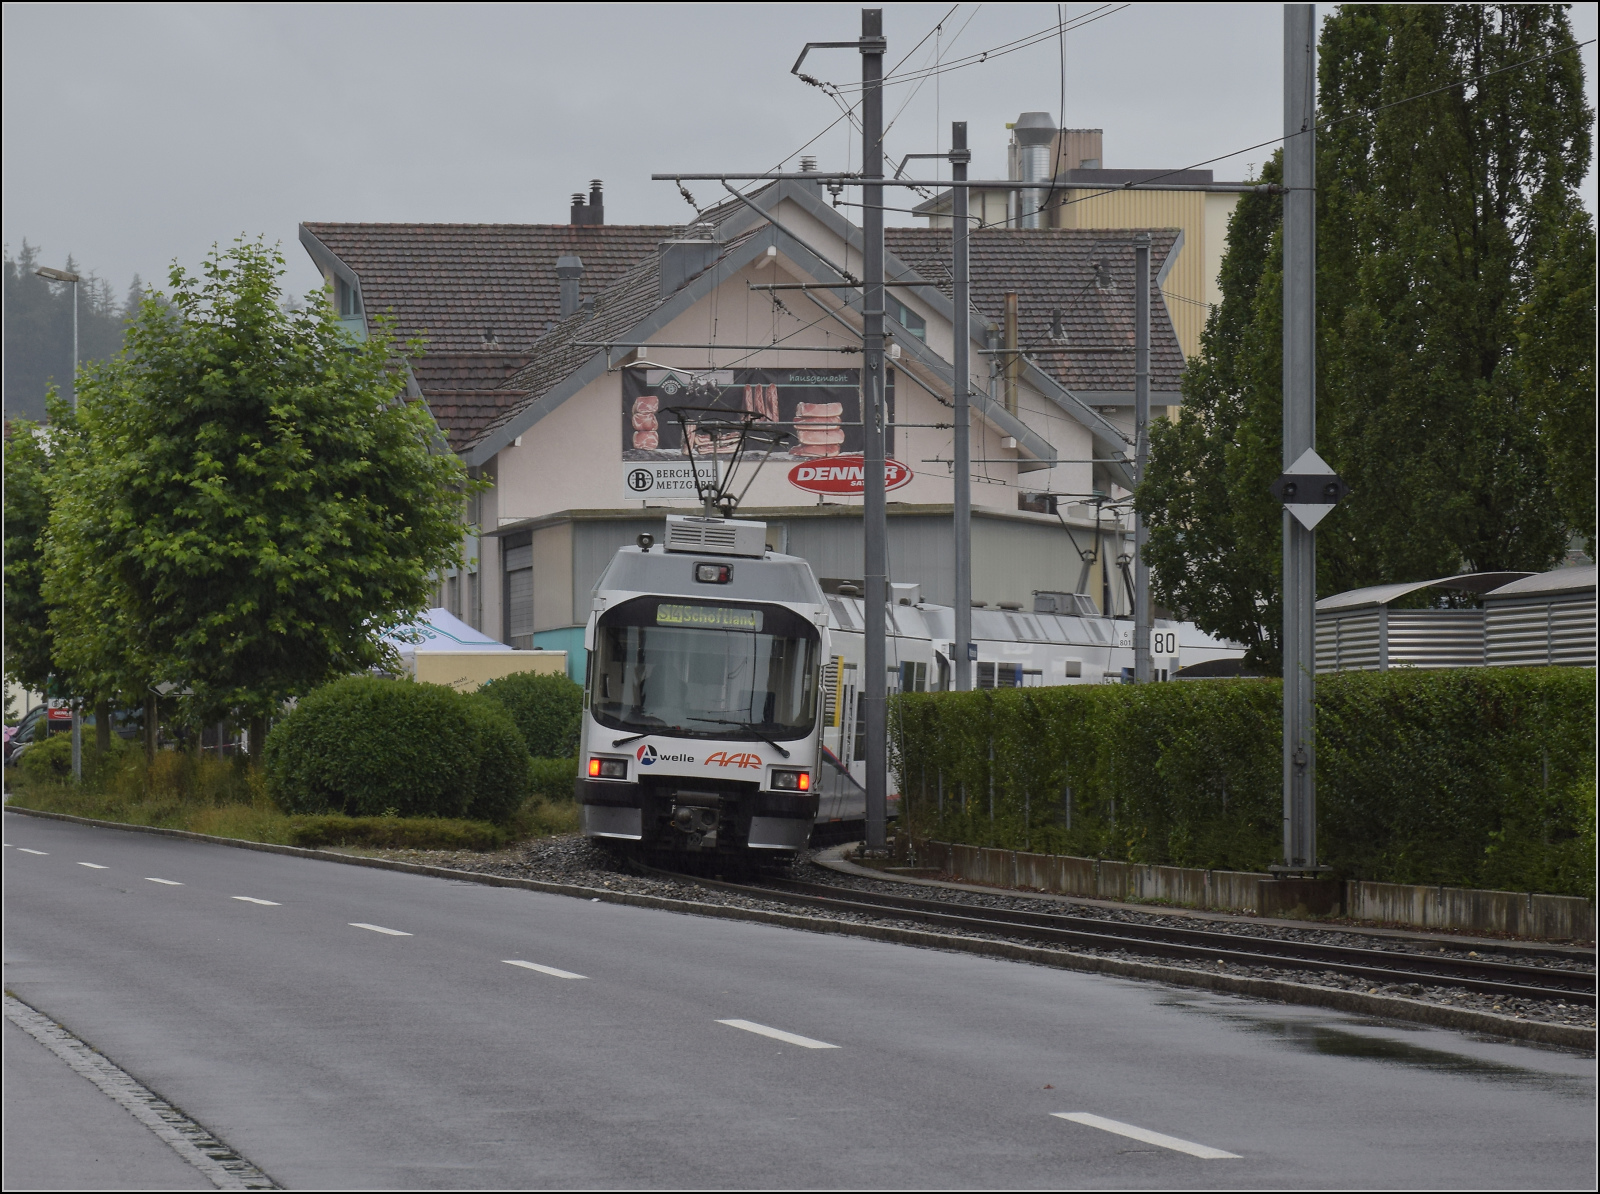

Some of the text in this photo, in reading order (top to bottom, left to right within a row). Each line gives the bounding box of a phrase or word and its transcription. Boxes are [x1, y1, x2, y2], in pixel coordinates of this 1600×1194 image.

[789, 374, 849, 385] hausgemacht
[796, 465, 899, 481] DENNR
[1154, 632, 1175, 654] 80
[660, 753, 695, 763] welle
[704, 751, 763, 770] AAR
